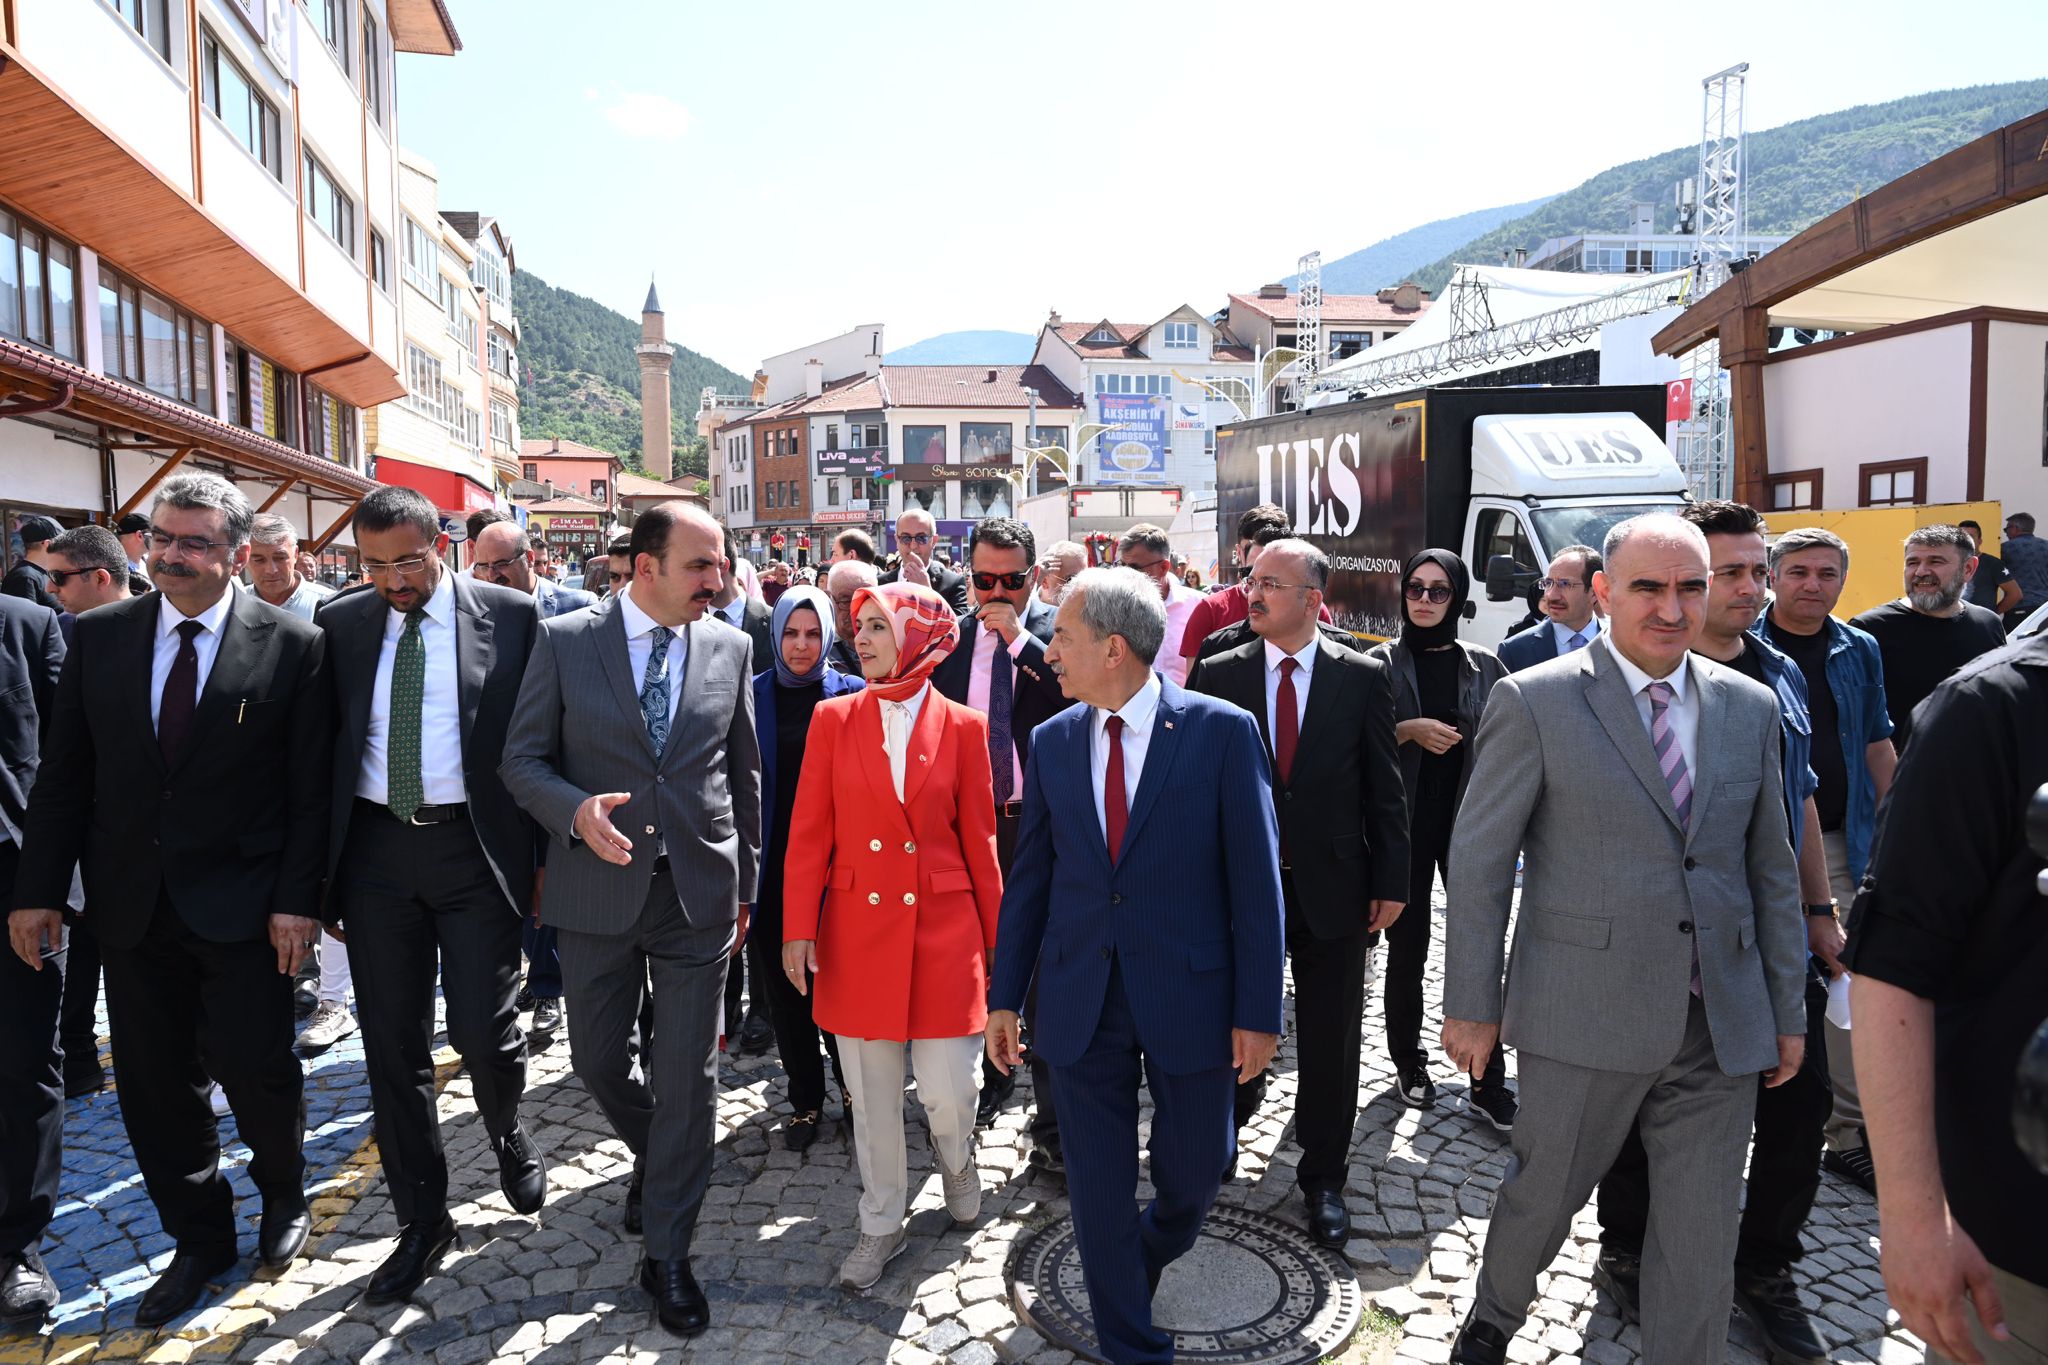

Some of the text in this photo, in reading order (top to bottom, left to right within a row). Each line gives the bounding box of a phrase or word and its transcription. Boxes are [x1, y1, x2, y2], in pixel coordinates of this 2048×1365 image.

[1524, 430, 1643, 466] UES
[1256, 431, 1362, 537] UES
[1336, 555, 1401, 574] ORGANİZASYON
